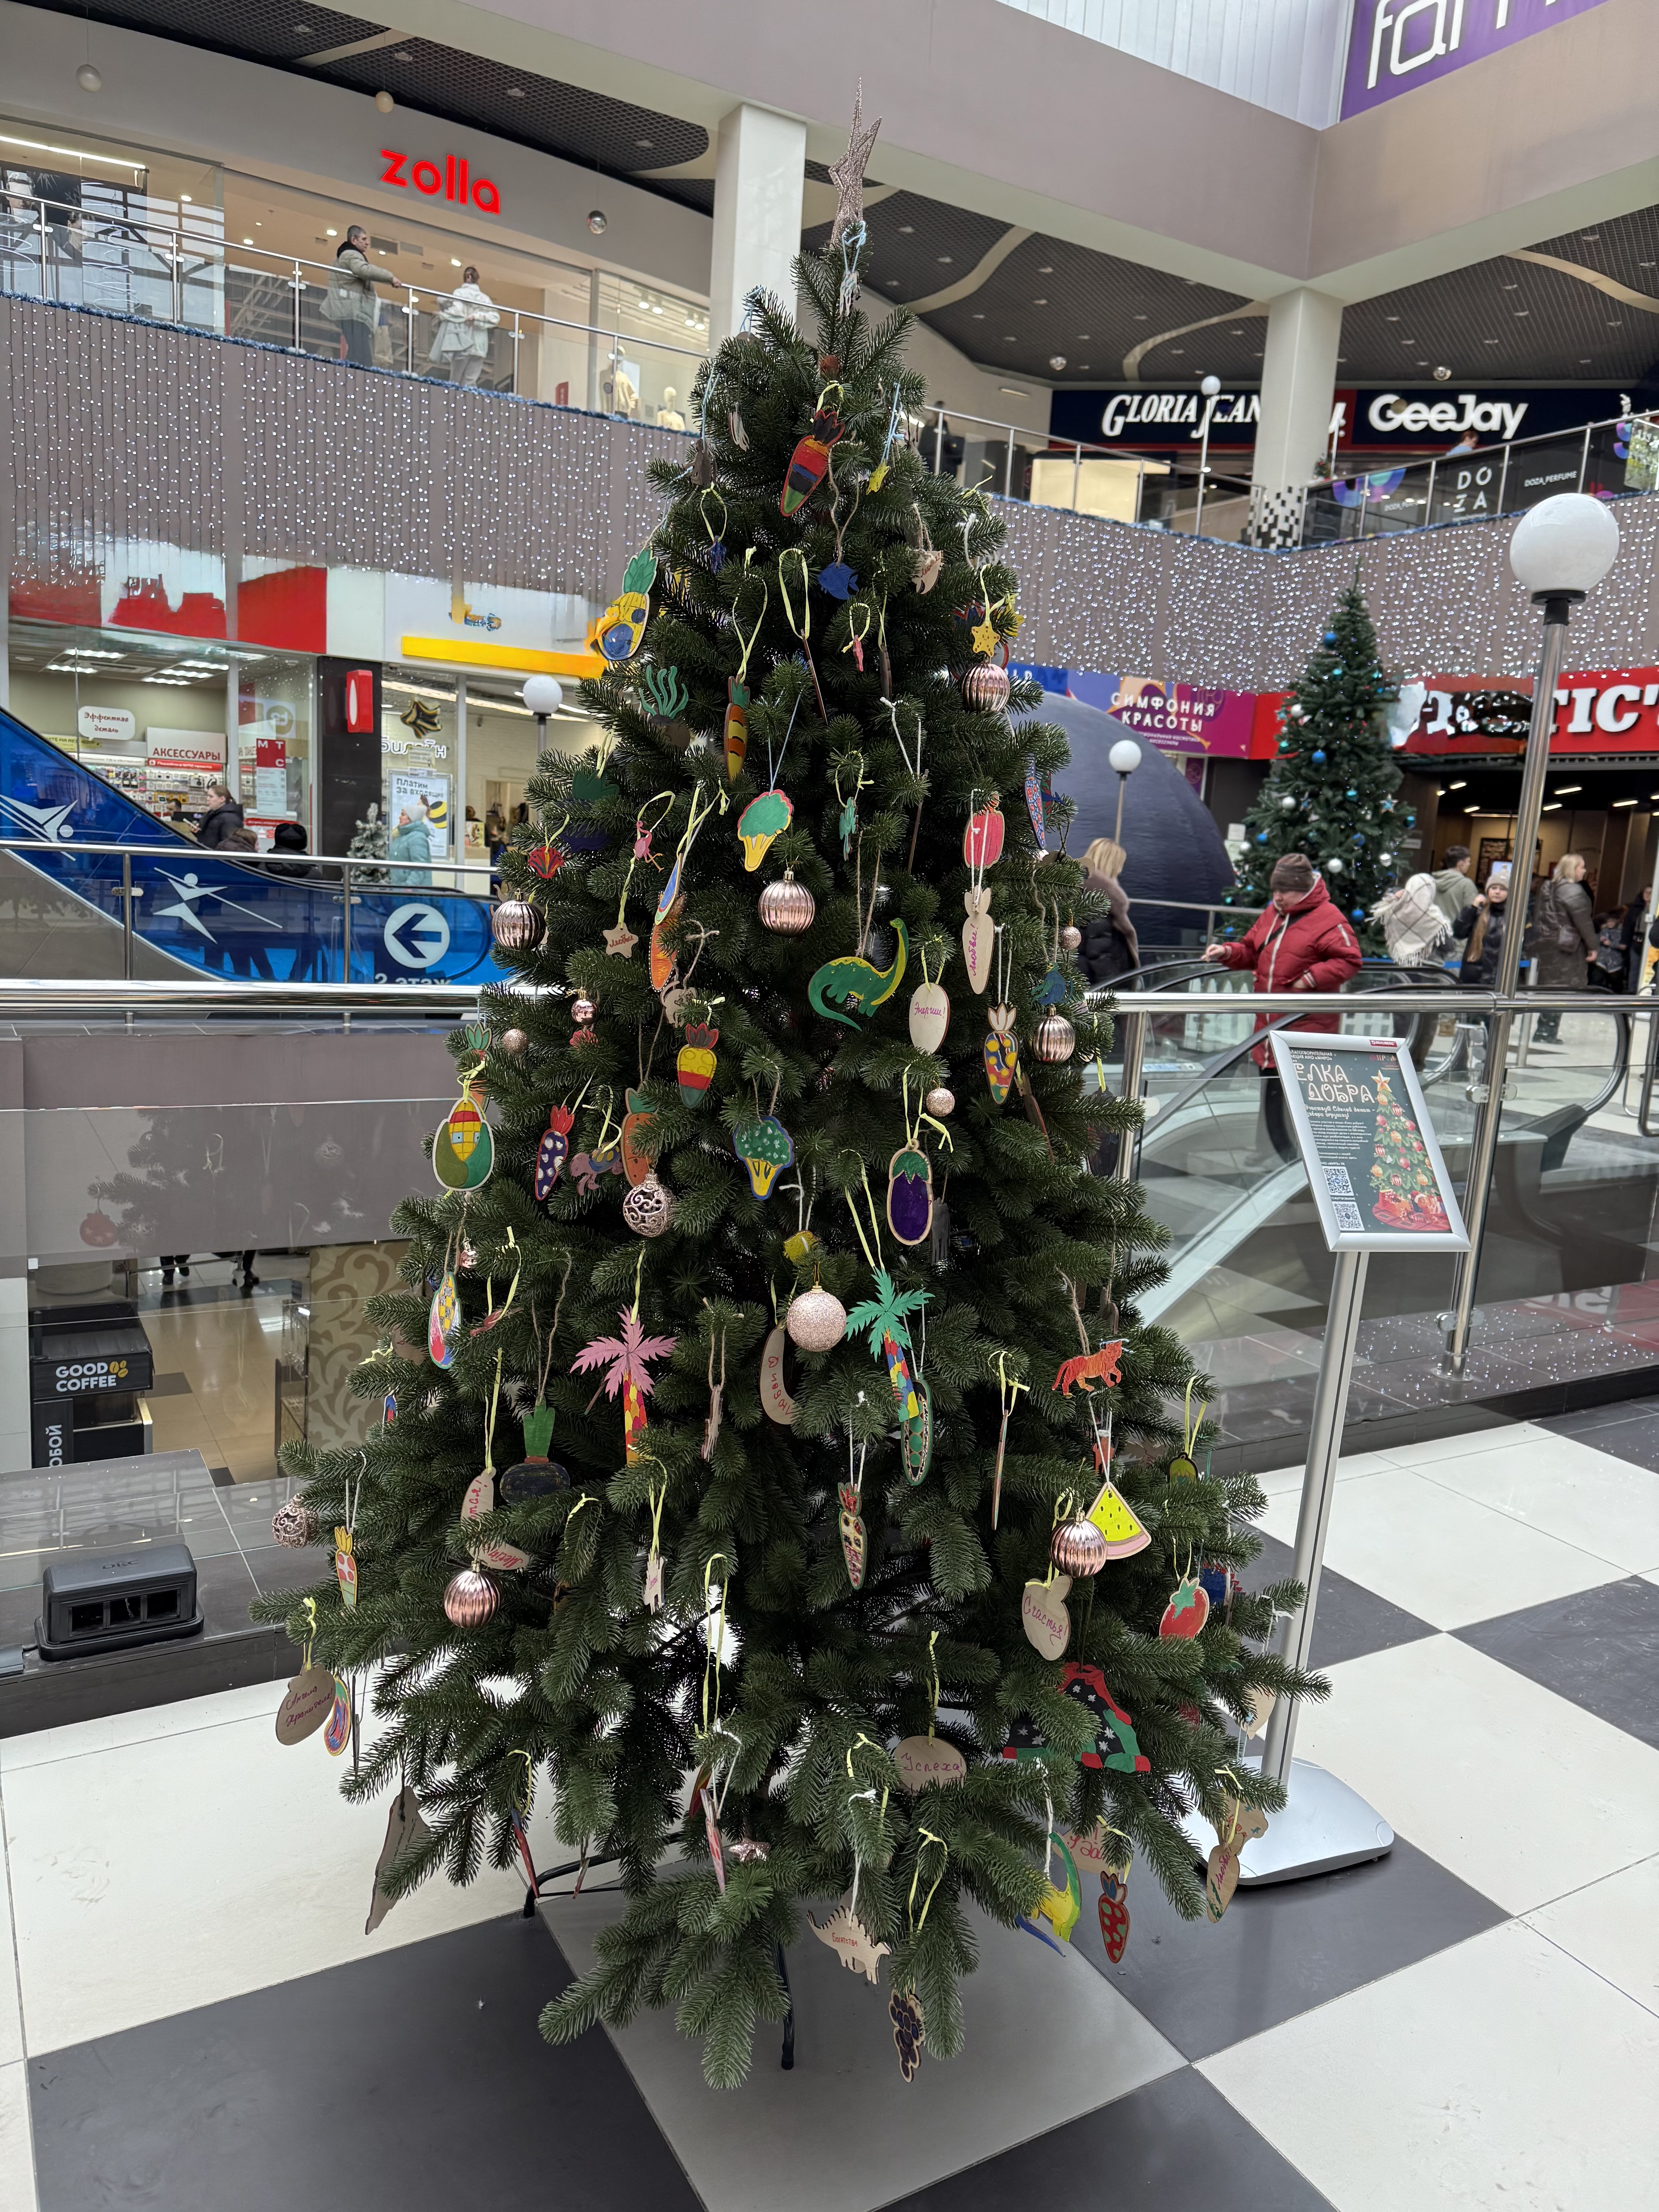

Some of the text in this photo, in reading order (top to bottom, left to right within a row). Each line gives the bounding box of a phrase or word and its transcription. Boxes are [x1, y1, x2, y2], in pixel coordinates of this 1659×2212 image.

[380, 149, 500, 215] zolla
[1102, 394, 1261, 438] GLORIA JEAN
[1368, 393, 1529, 439] GeeJay
[1111, 692, 1215, 717] СИМФОНИЯ
[1123, 711, 1202, 732] КРАСОТЫ
[153, 747, 220, 761] АКСЕССУАРЫ
[397, 778, 428, 788] платим
[375, 973, 387, 984] 2
[914, 1002, 946, 1019] Энергии!
[1293, 1060, 1349, 1084] ЁЛКА
[1308, 1083, 1375, 1104] ДОБРА
[56, 1362, 108, 1378] GOOD
[56, 1375, 117, 1392] COFFEE
[45, 1424, 62, 1467] ОБОЙ
[102, 1559, 140, 1569] DKC
[1024, 1594, 1068, 1646] Счастья!
